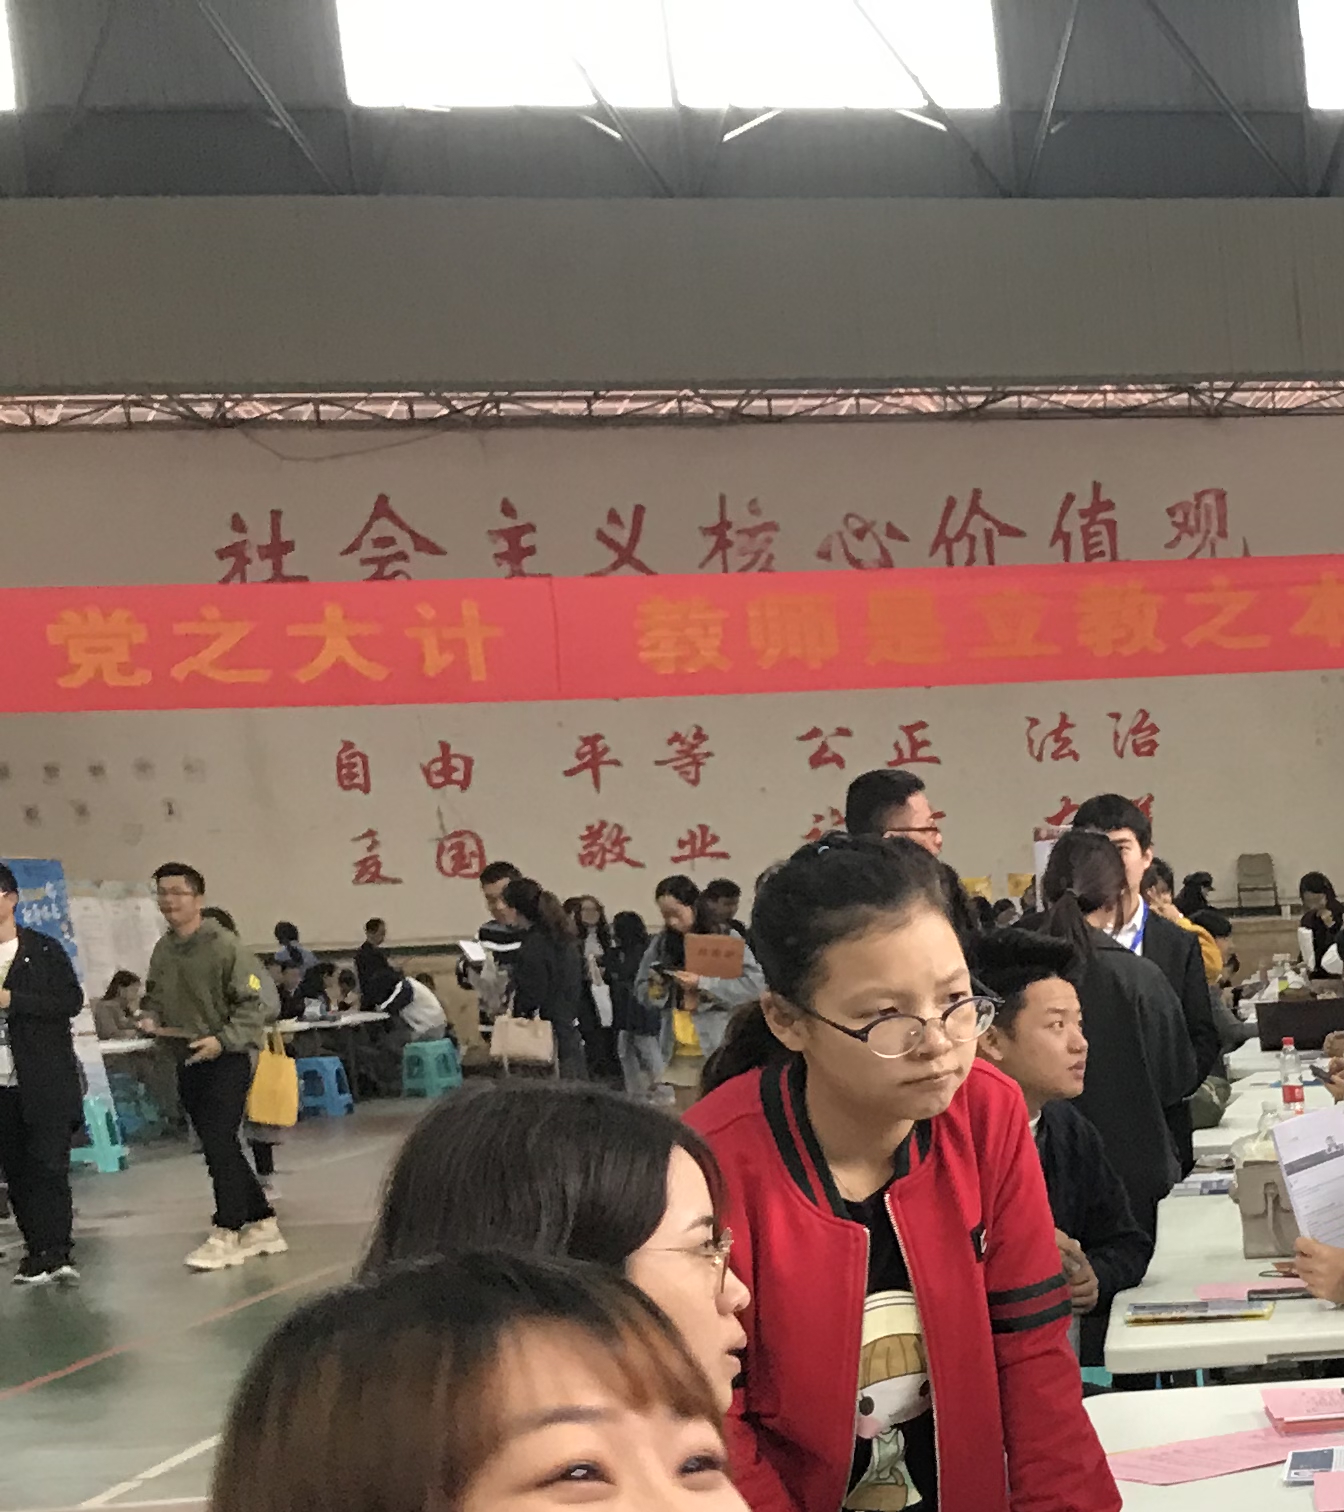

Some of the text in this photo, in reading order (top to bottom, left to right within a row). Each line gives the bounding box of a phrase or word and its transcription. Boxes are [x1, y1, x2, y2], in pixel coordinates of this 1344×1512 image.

[215, 481, 1252, 584] 社会主义核心价值观
[46, 598, 505, 691] 党之大计
[335, 708, 1161, 796] 自由 平等 公正 法治
[576, 820, 730, 871] 敬业
